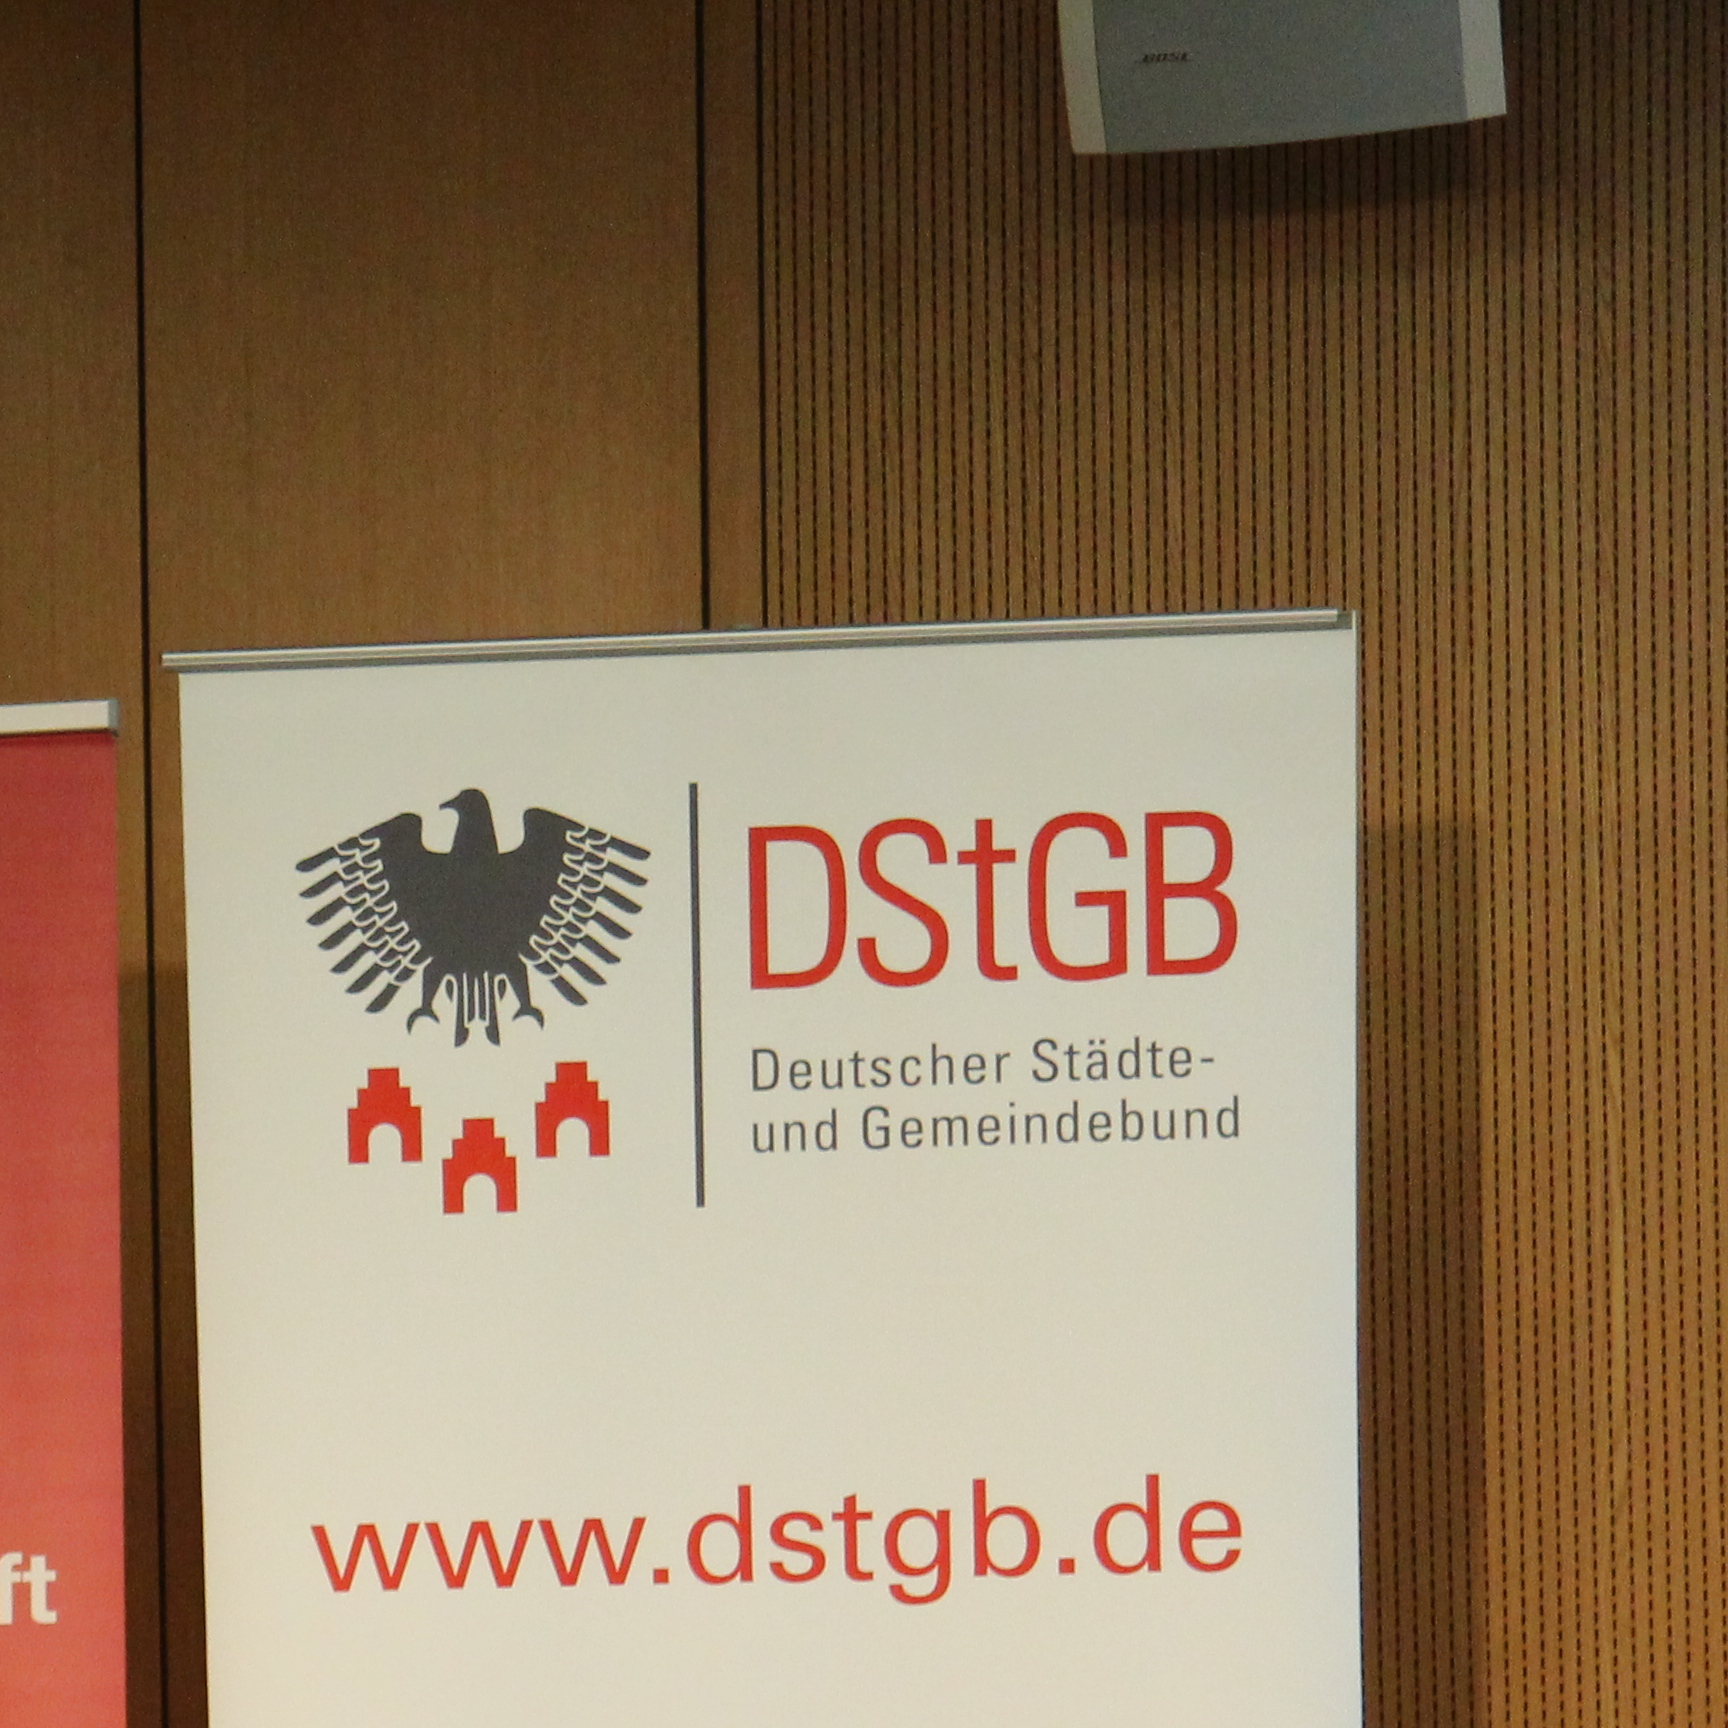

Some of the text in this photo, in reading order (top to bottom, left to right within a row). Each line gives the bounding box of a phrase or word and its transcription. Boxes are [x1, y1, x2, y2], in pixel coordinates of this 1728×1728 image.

[748, 810, 1238, 990] DStGB
[751, 1035, 1215, 1092] Deutscher Städte-
[751, 1094, 1240, 1154] und Gemeindebund
[311, 1473, 1243, 1606] www.dstgb.de
